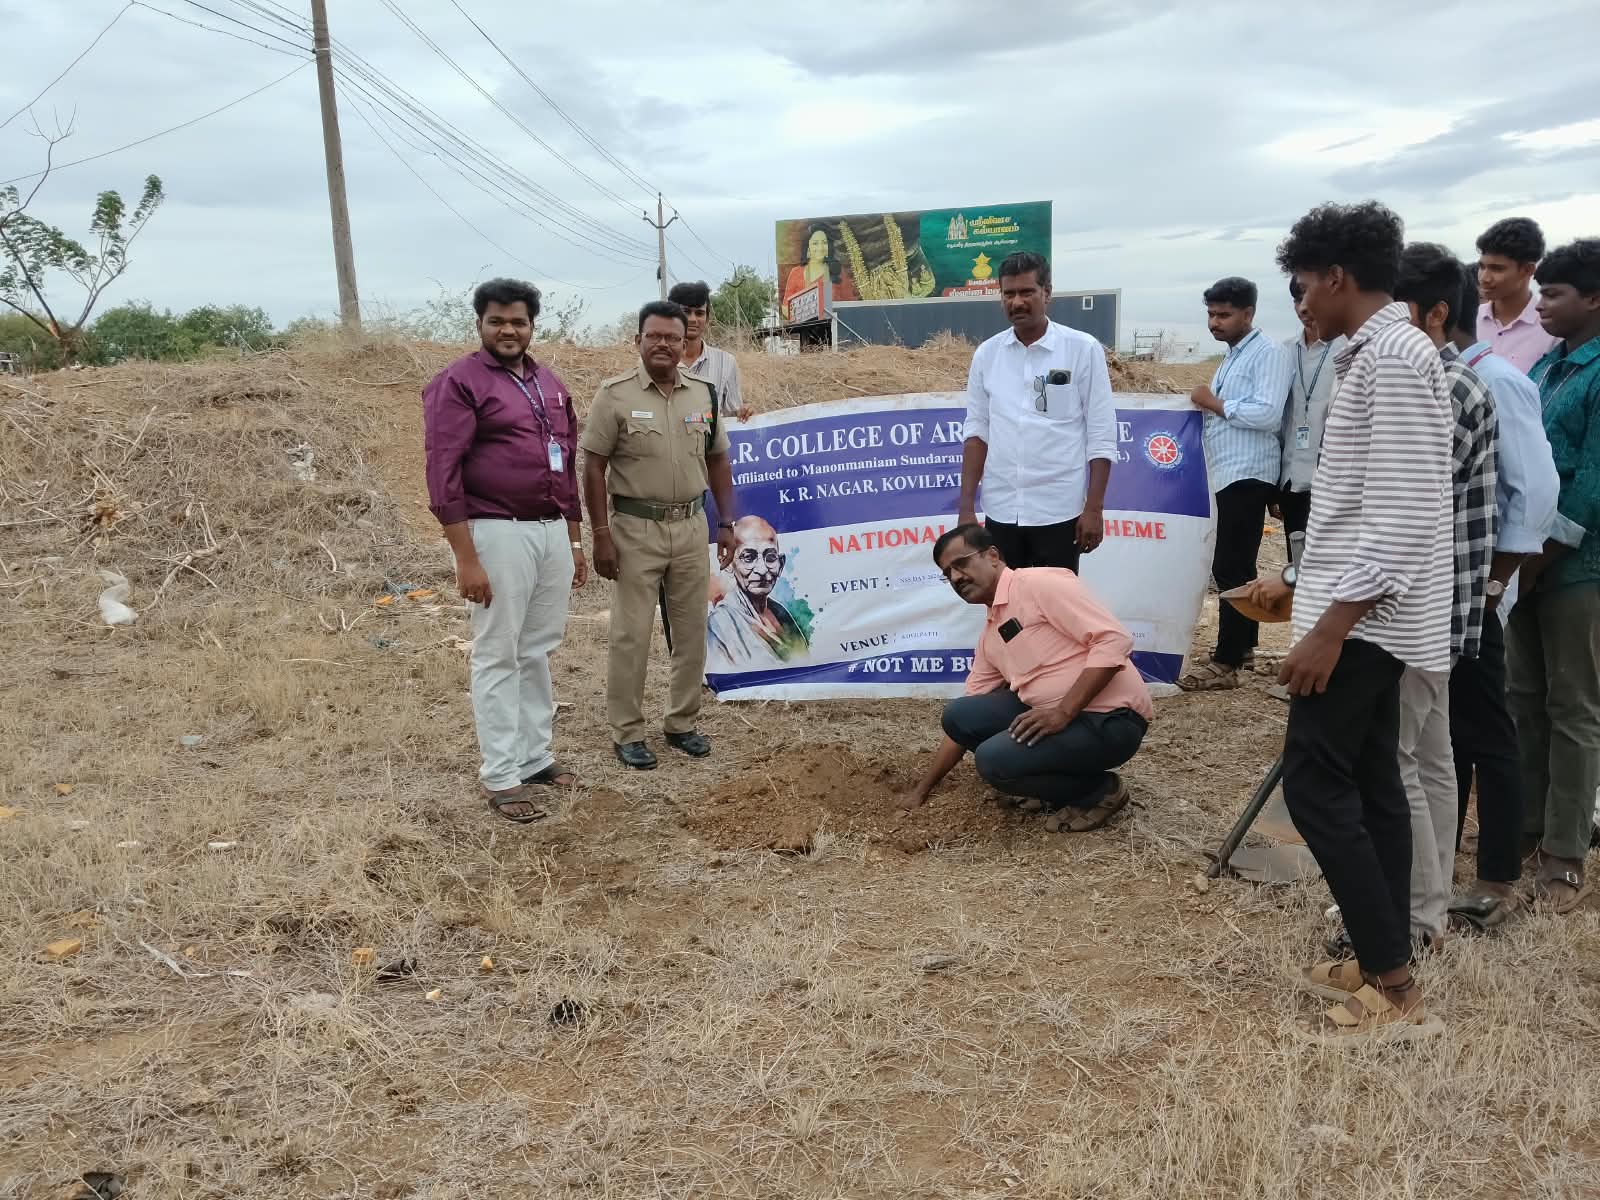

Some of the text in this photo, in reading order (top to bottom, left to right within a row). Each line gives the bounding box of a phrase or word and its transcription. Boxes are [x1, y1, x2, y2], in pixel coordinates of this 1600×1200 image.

[730, 421, 963, 465] .R. COLLEGE OF AR
[786, 466, 799, 479] to
[802, 457, 898, 476] Manonmaniam
[900, 453, 964, 466] Sundaran
[779, 473, 962, 504] K. R. NAGAR, KOVILPAT
[1104, 519, 1167, 540] HEME
[831, 577, 879, 594] EVENT
[840, 633, 889, 652] VENUE
[863, 656, 905, 673] NOT
[911, 656, 944, 673] ME
